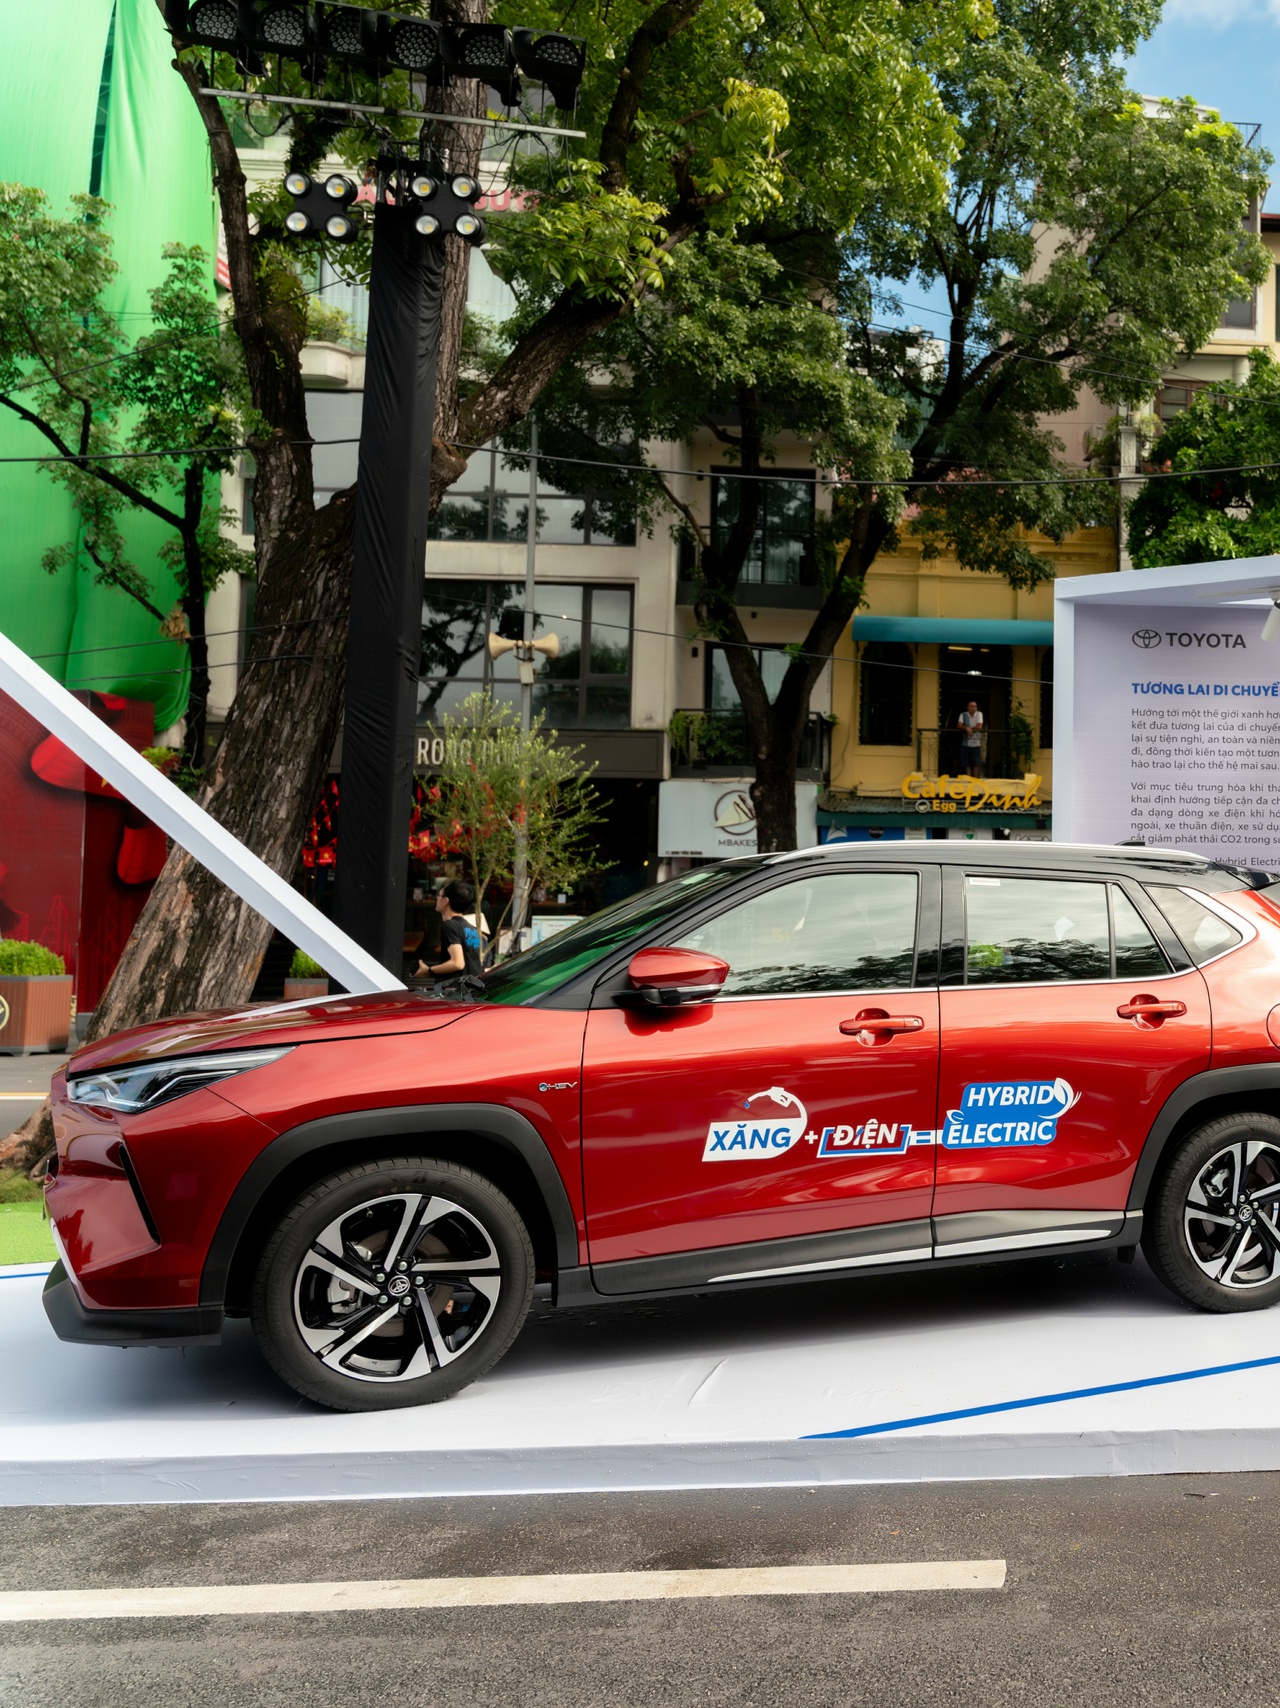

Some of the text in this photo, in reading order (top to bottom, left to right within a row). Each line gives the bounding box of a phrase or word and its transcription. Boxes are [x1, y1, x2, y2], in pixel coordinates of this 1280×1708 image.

[1165, 632, 1247, 649] TOYOTA
[1131, 681, 1185, 695] TƯƠNG
[1187, 683, 1210, 696] LAI
[1213, 684, 1228, 696] DI
[1132, 708, 1165, 720] Hướng
[1166, 708, 1179, 718] tới
[1182, 708, 1201, 720] một
[1203, 708, 1219, 718] thế
[1220, 709, 1239, 721] giới
[1241, 709, 1264, 719] xanh
[1132, 720, 1147, 730] kết
[1149, 721, 1168, 730] đưa
[1171, 722, 1200, 733] tương
[1203, 721, 1215, 731] lai
[1217, 722, 1235, 731] của
[1237, 722, 1247, 732] di
[1131, 733, 1143, 745] lại
[1146, 736, 1157, 745] sự
[1159, 733, 1178, 745] tiện
[1180, 734, 1205, 746] nghi,
[1222, 735, 1244, 744] toàn
[1246, 735, 1257, 744] và
[1131, 746, 1143, 757] đi,
[1146, 746, 1171, 758] đồng
[1174, 747, 1193, 756] thời
[1196, 746, 1215, 756] kiến
[1218, 748, 1234, 759] tạo
[1236, 748, 1255, 759] một
[901, 774, 966, 800] Cafe
[932, 800, 957, 813] Egg
[718, 838, 758, 847] MBAKES
[1148, 833, 1172, 845] giảm
[1174, 833, 1197, 845] phát
[1199, 834, 1218, 843] thải
[1220, 834, 1241, 843] CO2
[1244, 835, 1271, 846] trong
[967, 1085, 1055, 1107] HYBRID
[709, 1123, 792, 1152] XĂNG
[833, 1118, 898, 1149] ĐIỆN
[947, 1121, 1053, 1145] ELECTRIC
